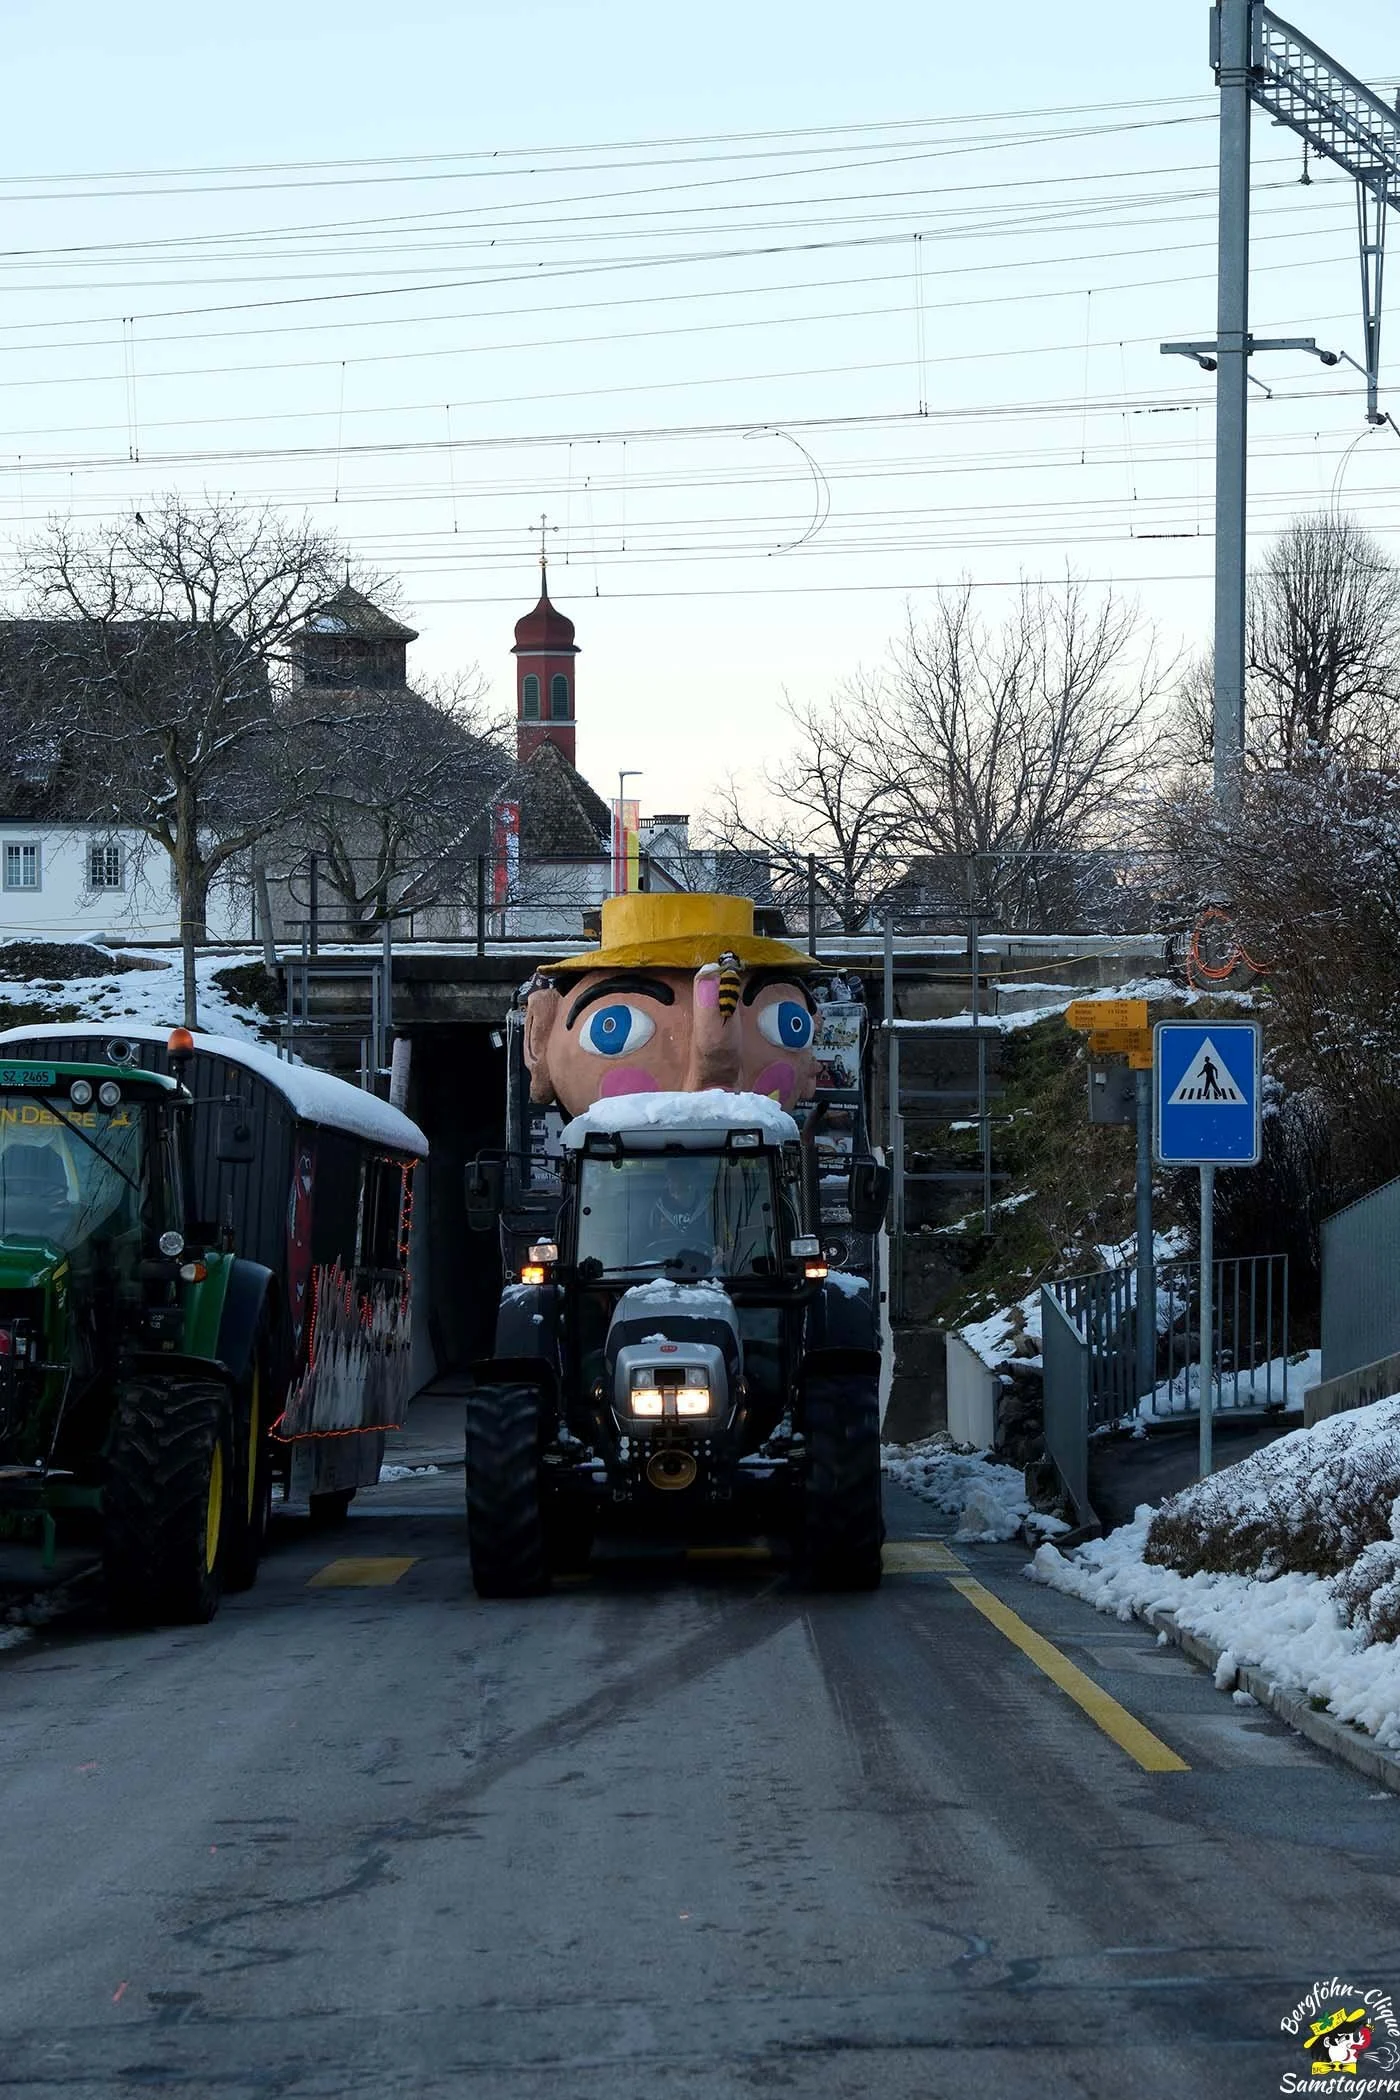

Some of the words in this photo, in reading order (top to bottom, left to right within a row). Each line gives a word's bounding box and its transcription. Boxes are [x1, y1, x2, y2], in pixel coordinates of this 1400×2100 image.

[2, 1070, 16, 1083] SZ
[23, 1071, 49, 1083] 2465
[22, 1105, 97, 1128] DEERE
